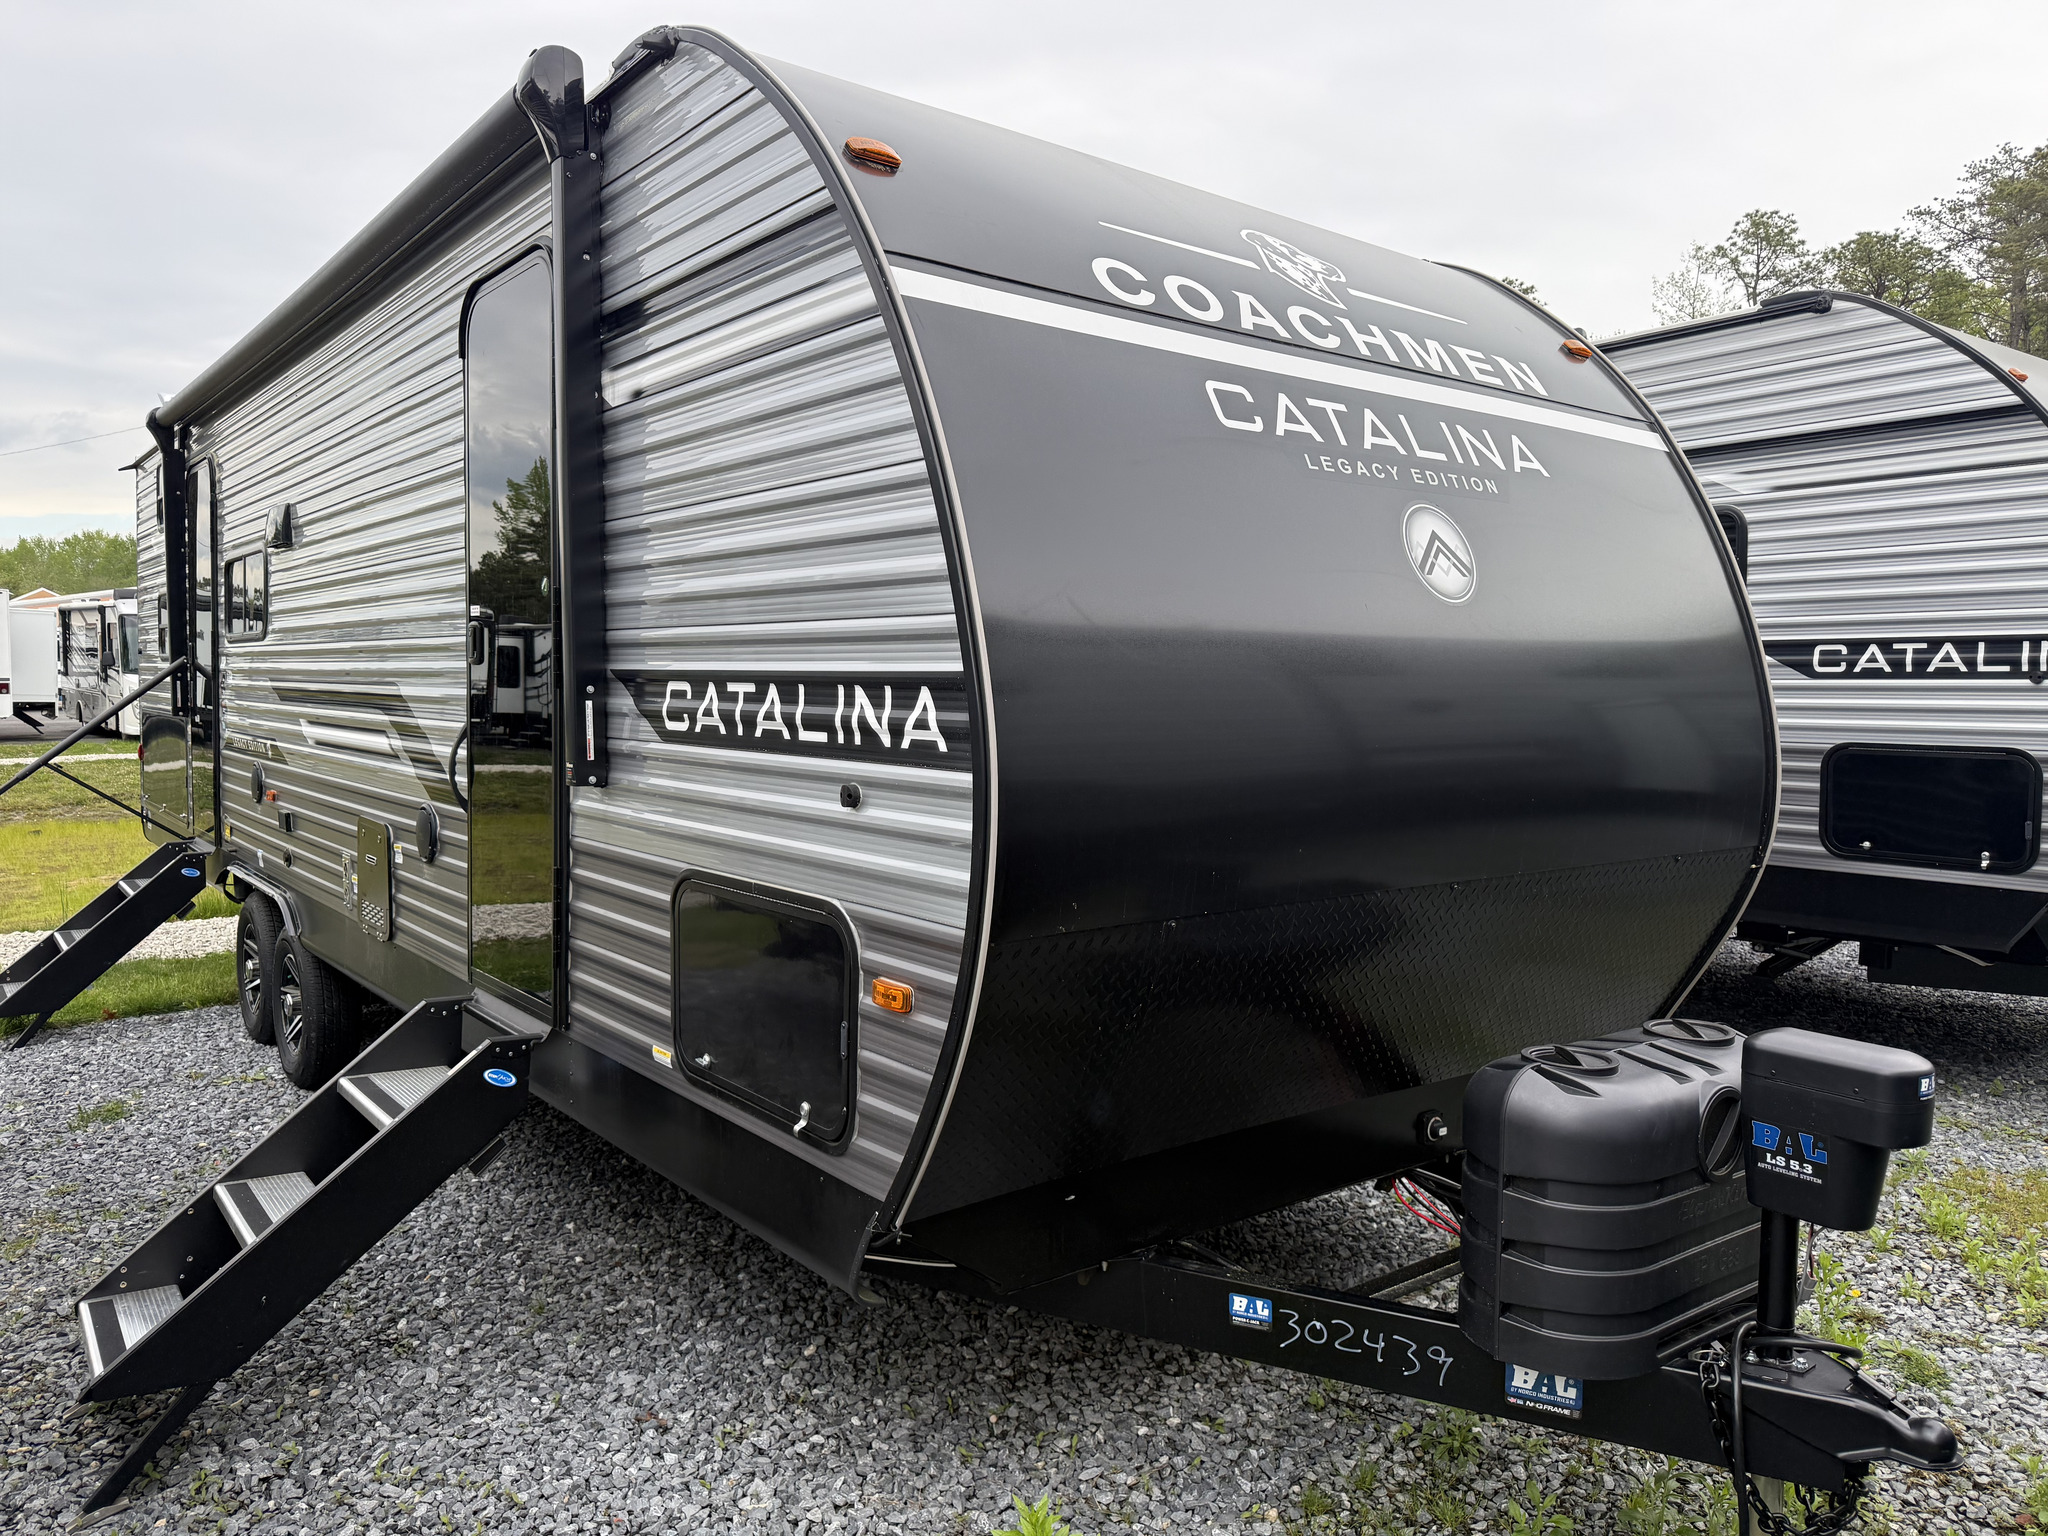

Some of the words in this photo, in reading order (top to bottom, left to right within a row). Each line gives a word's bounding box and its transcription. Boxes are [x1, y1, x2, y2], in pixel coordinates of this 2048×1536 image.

[1091, 256, 1549, 397] COACHMEN
[1204, 379, 1552, 479] CATALINA
[1303, 452, 1400, 482] LEGACY
[1413, 467, 1500, 495] EDITION
[1811, 639, 2048, 674] CATALI
[661, 680, 949, 754] CATALINA
[1751, 1120, 1828, 1165] BAL
[1757, 1162, 1772, 1170] AUTO
[1772, 1166, 1799, 1178] LEVELING
[1799, 1173, 1823, 1185] SYSTEM
[1766, 1152, 1786, 1167] LS
[1789, 1159, 1813, 1174] 5.3
[1232, 1295, 1269, 1316] BAL
[1278, 1308, 1455, 1387] 302439
[1511, 1364, 1577, 1399] BAL
[1518, 1388, 1536, 1396] NORCO
[1543, 1405, 1571, 1415] FRAME
